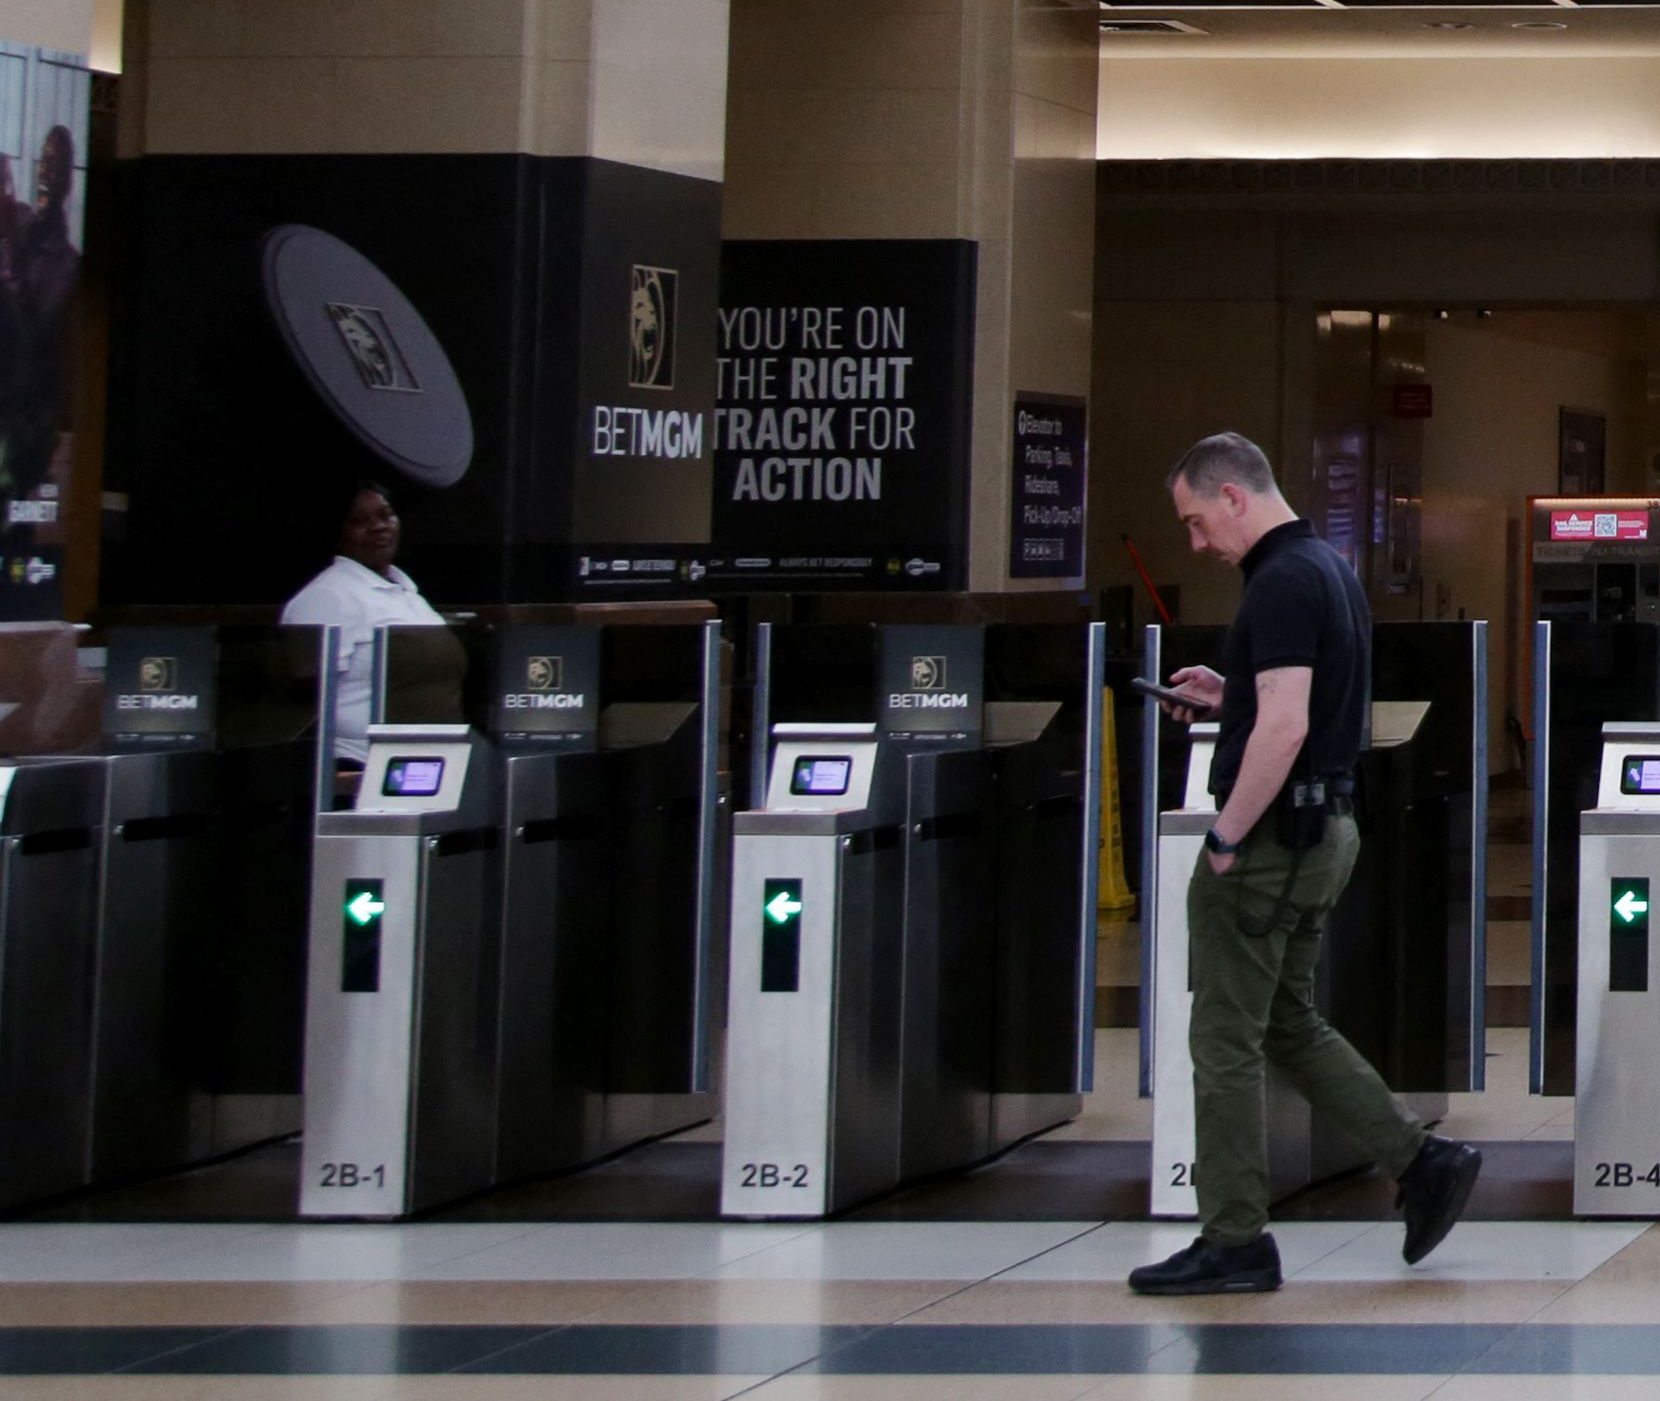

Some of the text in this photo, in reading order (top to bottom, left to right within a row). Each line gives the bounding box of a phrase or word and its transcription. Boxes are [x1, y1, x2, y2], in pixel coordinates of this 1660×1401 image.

[718, 305, 906, 351] YOU'RE ON
[717, 356, 914, 400] THE RIGHT
[593, 405, 703, 460] BETMGM
[713, 406, 916, 451] TRACK FOR
[732, 457, 883, 502] ACTION
[119, 693, 198, 710] BETMGM
[505, 692, 584, 709] BETMGM
[889, 691, 968, 708] BETMGM
[319, 1162, 386, 1188] 2B-1
[741, 1163, 808, 1188] 2B-2
